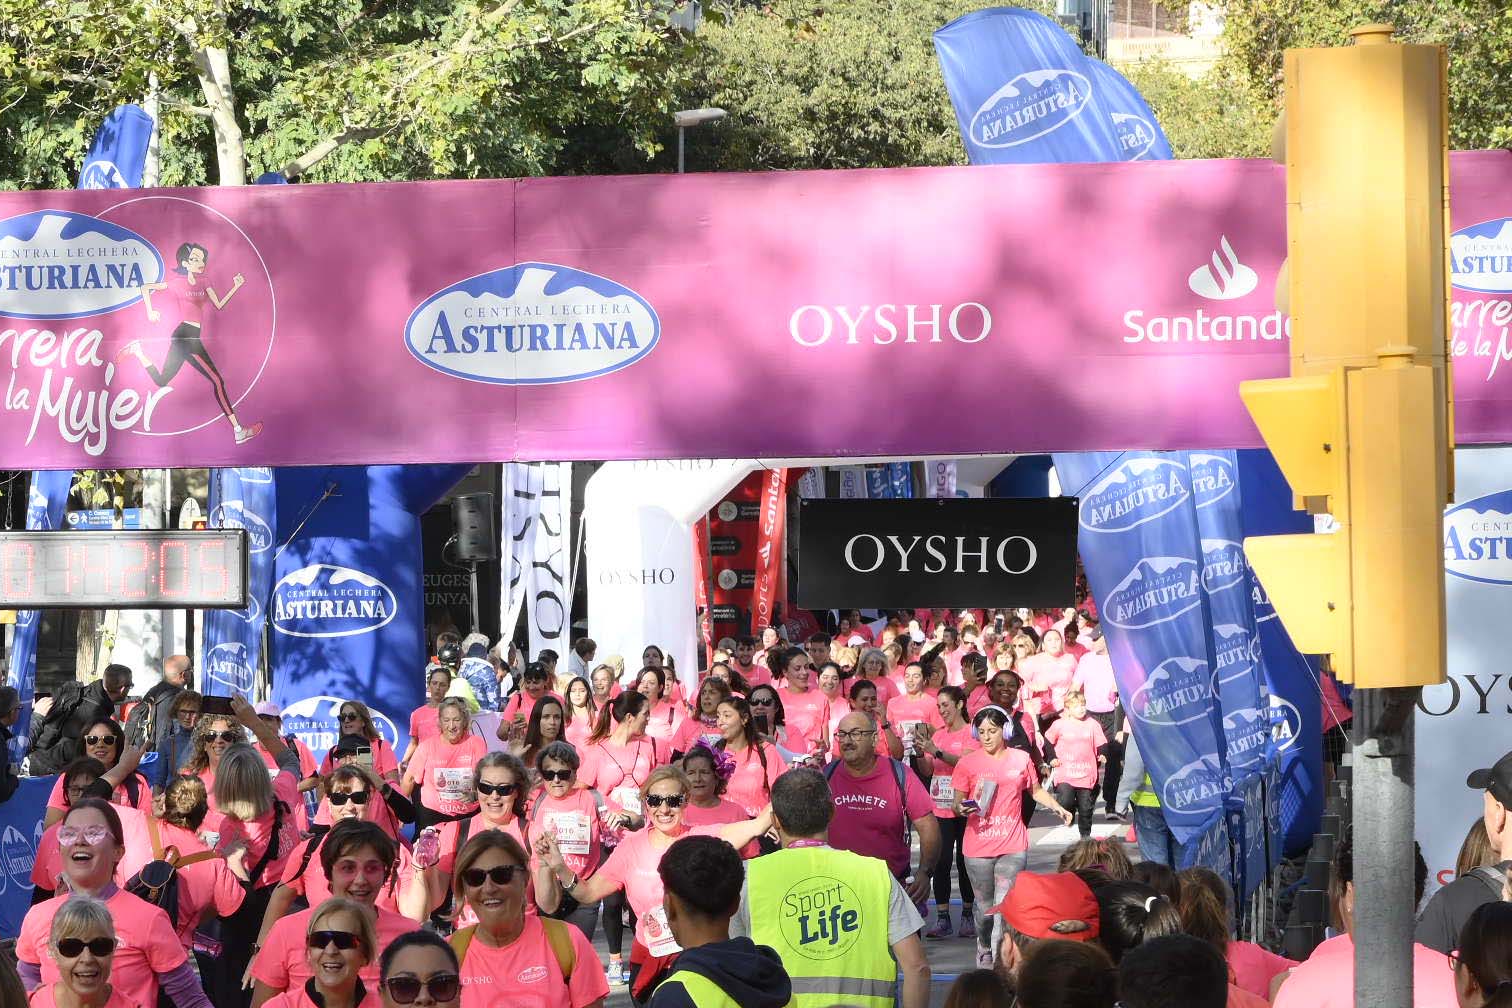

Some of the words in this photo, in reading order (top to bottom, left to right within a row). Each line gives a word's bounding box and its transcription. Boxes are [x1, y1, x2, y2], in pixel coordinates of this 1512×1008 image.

[66, 247, 139, 258] LECHERA
[464, 306, 543, 319] CENTRAL
[551, 303, 632, 317] LECHERA
[789, 302, 993, 346] OYSHO
[1451, 300, 1512, 328] arre
[425, 309, 641, 354] ASTURIANA
[1474, 327, 1492, 356] la
[5, 369, 30, 410] la
[25, 361, 174, 456] Mujer
[1471, 522, 1512, 531] CENT
[844, 534, 1037, 574] OYSHO
[599, 567, 675, 584] OYSHO
[275, 594, 388, 621] ASTURIANA
[287, 590, 328, 598] CENTRAL
[288, 721, 328, 730] CENTRAL
[835, 795, 887, 808] CHANETE
[785, 883, 844, 917] Sport
[798, 905, 858, 945] Life
